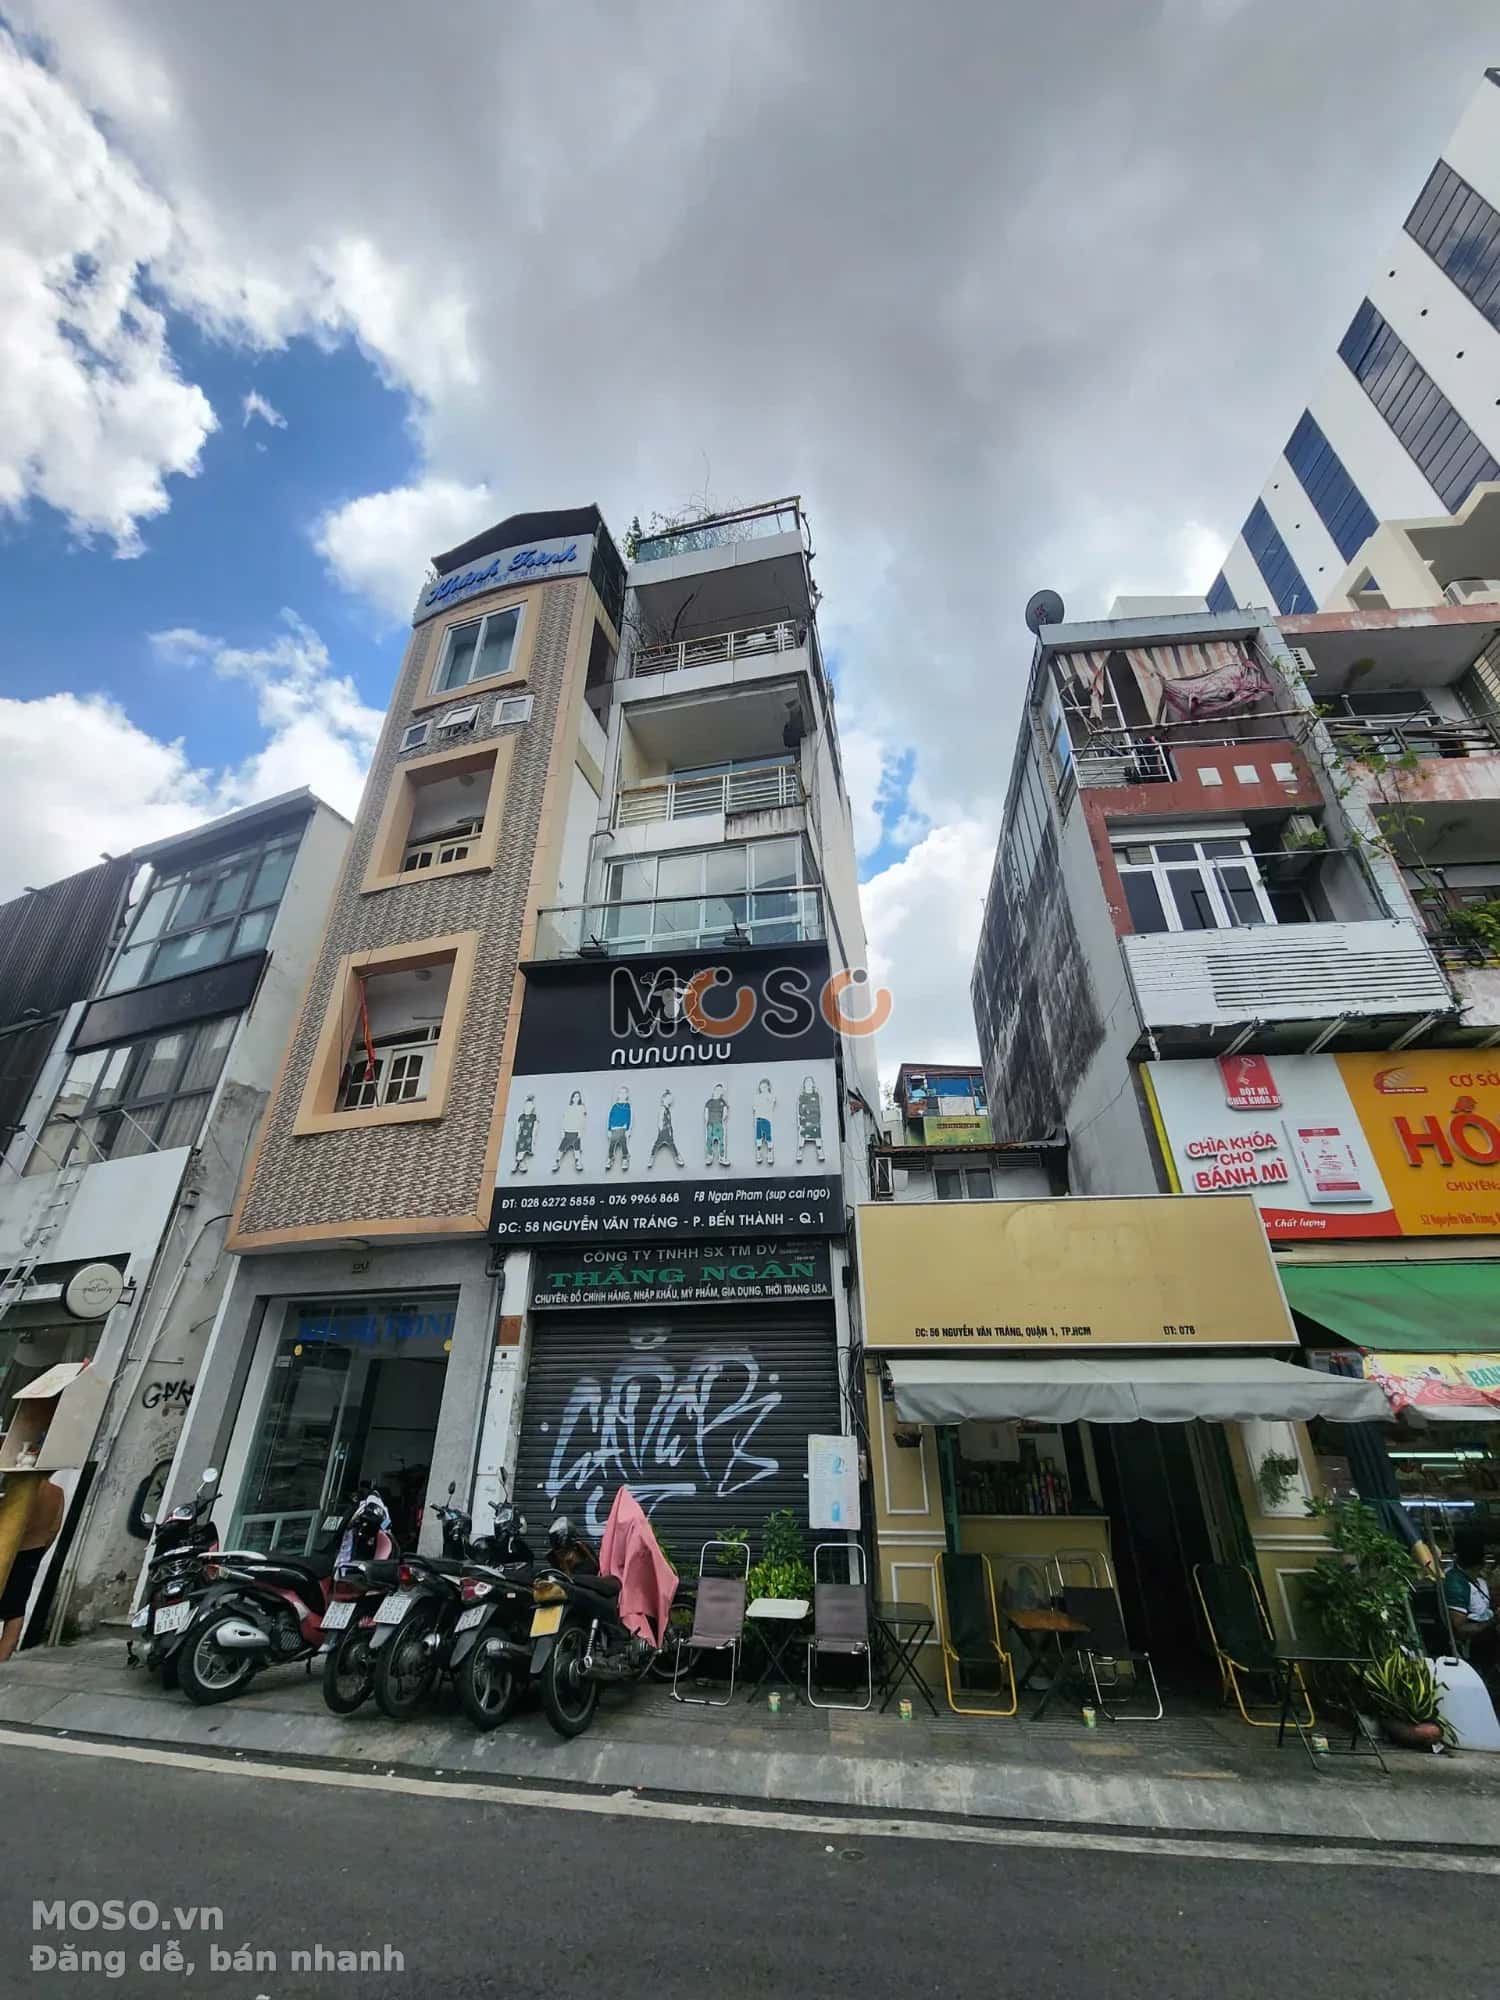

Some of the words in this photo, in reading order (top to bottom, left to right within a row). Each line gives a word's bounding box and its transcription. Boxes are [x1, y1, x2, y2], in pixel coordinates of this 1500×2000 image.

[1188, 1137, 1227, 1156] CHÌA
[1230, 1131, 1277, 1150] KHÓA
[1219, 1151, 1254, 1166] CHO
[1195, 1166, 1257, 1189] BÁNH
[1262, 1157, 1288, 1181] MÌ
[502, 1199, 517, 1209] ĐT:
[521, 1198, 539, 1208] 028
[541, 1197, 566, 1207] 6272
[569, 1196, 596, 1206] 5858
[609, 1195, 627, 1205] 076
[630, 1194, 657, 1204] 9966
[659, 1193, 680, 1203] 868
[694, 1191, 705, 1202] FB
[708, 1190, 733, 1204] Ngan
[736, 1189, 762, 1200] Pham
[765, 1188, 786, 1201] (sup
[807, 1187, 830, 1201] ngo)
[498, 1222, 521, 1234] ĐC:
[525, 1221, 540, 1232] 58
[543, 1215, 598, 1232] NGUYỄN
[603, 1215, 628, 1230] VĂN
[633, 1214, 678, 1229] TRÁNG
[693, 1216, 704, 1227] P.
[708, 1209, 734, 1227] BẾN
[739, 1211, 784, 1226] THÀNH
[633, 1250, 653, 1260] TY
[657, 1247, 699, 1262] TNHH
[703, 1247, 724, 1258] SX
[729, 1246, 751, 1257] TM
[756, 1244, 777, 1256] DV
[546, 1263, 686, 1287] THẮNG
[700, 1260, 816, 1281] NGÂN
[535, 1291, 568, 1304] CHUYÊN:
[634, 1288, 655, 1303] NHẬP
[656, 1284, 679, 1300] KHẨU,
[681, 1286, 693, 1298] MỸ
[695, 1283, 720, 1298] PHẨM,
[721, 1286, 736, 1297] GIA
[737, 1286, 763, 1299] DỤNG,
[783, 1283, 809, 1295] TRANG
[811, 1283, 828, 1294] USA
[942, 1324, 973, 1337] NGUYỄN
[1026, 1326, 1047, 1338] QUẬN
[1050, 1327, 1057, 1338] 1,
[1061, 1326, 1091, 1336] TP.HCM
